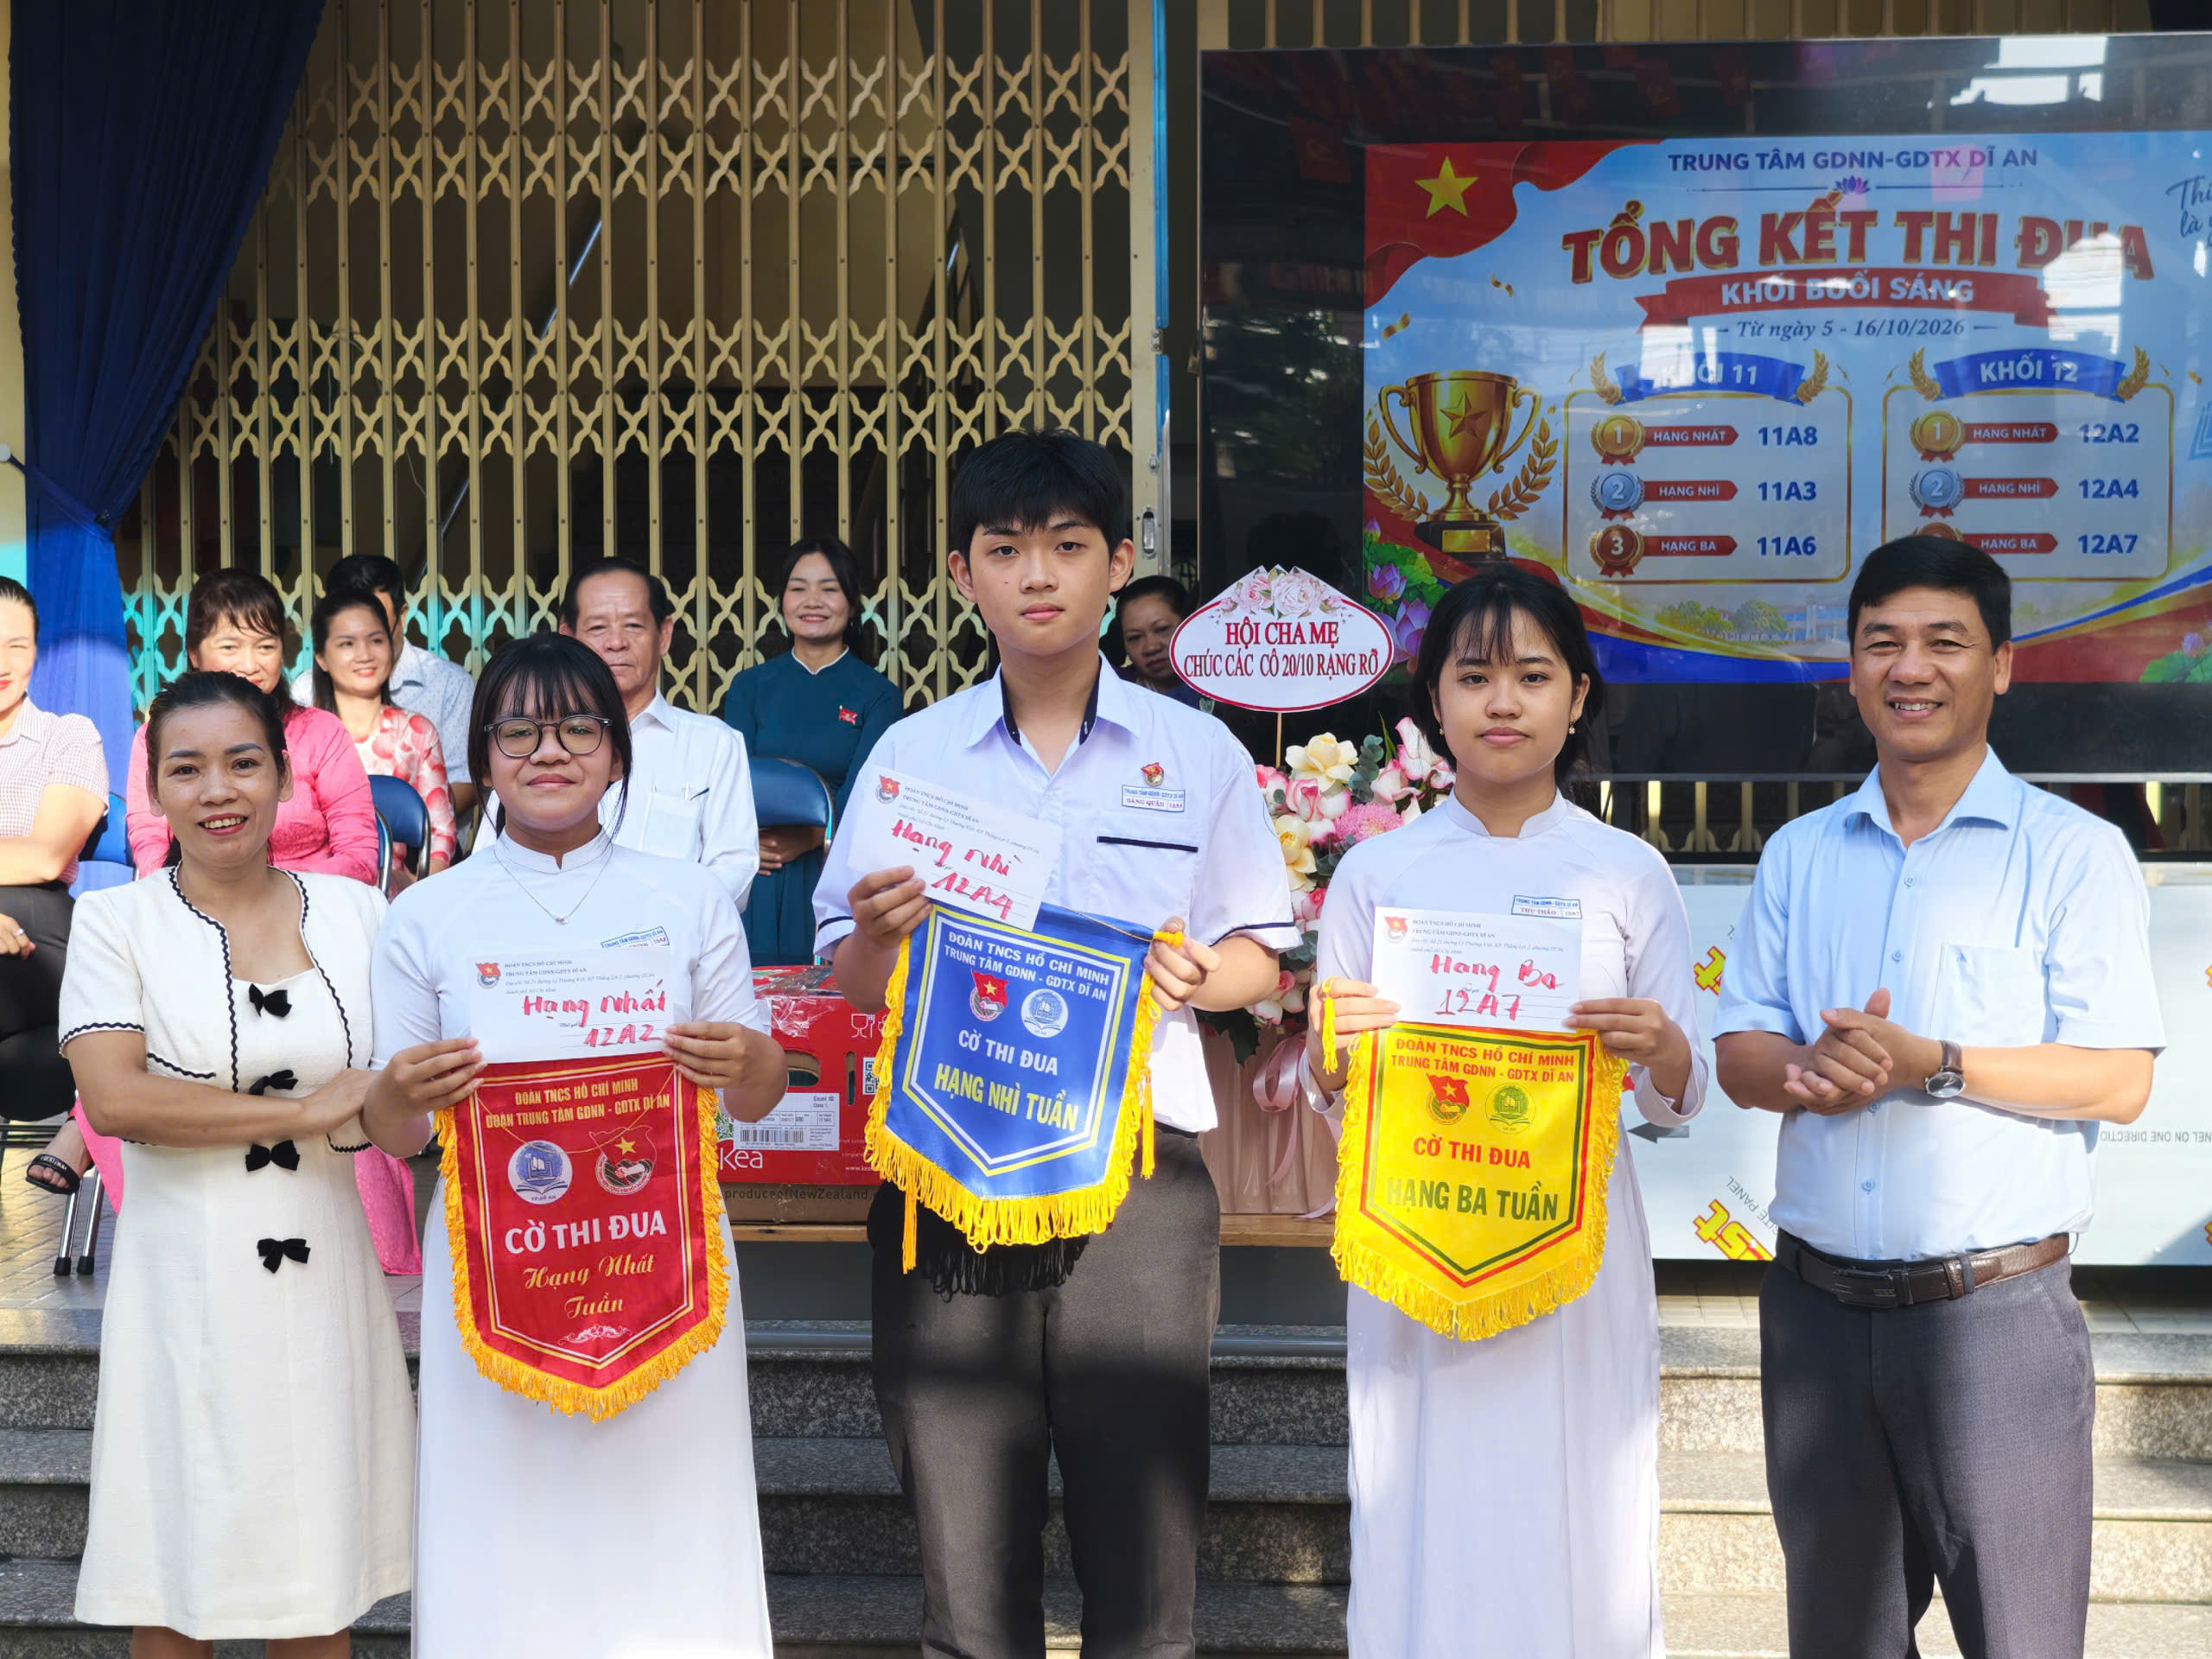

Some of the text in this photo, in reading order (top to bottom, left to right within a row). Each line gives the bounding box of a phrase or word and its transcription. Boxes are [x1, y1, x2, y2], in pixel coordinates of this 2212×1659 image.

[1668, 145, 2037, 172] TRUNG TÂM GDNN-GDTX DĨ AN
[1561, 200, 1740, 284] TỔNG
[1758, 190, 1878, 266] KẾT
[1893, 210, 1999, 267] THI
[1890, 272, 1974, 302] SÁNG
[1737, 317, 1965, 341] Từ ngày 5 16/10/2026
[1732, 364, 1758, 385] 11
[1979, 353, 2078, 384] KHỐI 12
[1613, 425, 1623, 445] 1
[1692, 428, 1726, 442] NHẤT
[1758, 426, 1818, 446] 11A8
[1931, 422, 1942, 441] 1
[2012, 423, 2046, 438] NHẤT
[2079, 423, 2139, 444] 12A2
[1611, 480, 1625, 500] 2
[1697, 484, 1720, 497] NHÌ
[1758, 480, 1817, 501] 11A3
[1930, 477, 1944, 498] 2
[2018, 480, 2040, 493] NHÌ
[2078, 478, 2139, 499] 12A4
[1611, 536, 1624, 556] 3
[1700, 541, 1717, 551] BA
[1756, 536, 1817, 556] 11A6
[2019, 538, 2037, 550] BA
[2077, 534, 2139, 554] 12A7
[1224, 615, 1339, 650] HỘI CHA MẸ
[1184, 647, 1379, 681] CHÚC CÁC CÔ 20/10 RẠNG RỠ
[890, 818, 954, 868] Hạng
[931, 871, 1014, 921] 12A4
[948, 931, 1110, 986] ĐOÀN TNCS HỒ CHÍ MINH
[944, 944, 976, 967] TRUNG
[978, 954, 1002, 974] TÂM
[1004, 963, 1037, 982] GDNN
[1045, 974, 1075, 993] GDTX
[1091, 987, 1107, 1002] AN
[1431, 953, 1565, 993] Hạng Ba
[523, 995, 590, 1028] Hạng
[1433, 988, 1526, 1021] 12A7
[583, 1023, 663, 1048] 12A2
[957, 1027, 1058, 1076] CỜ THI ĐUA
[1395, 1038, 1574, 1066] ĐOÀN TNCS HỒ CHÍ MINH
[1391, 1054, 1430, 1070] TRUNG
[1433, 1058, 1459, 1073] TÂM
[1463, 1063, 1497, 1077] GDNN
[1507, 1068, 1538, 1082] GDTX
[1557, 1071, 1574, 1083] AN
[515, 1077, 639, 1106] ĐOÀN TNCS HỒ CHÍ MINH
[933, 1063, 1080, 1133] HẠNG NHÌ TUẦN
[486, 1109, 515, 1128] ĐOÀN
[517, 1109, 550, 1127] TRUNG
[551, 1105, 574, 1123] TÂM
[576, 1104, 606, 1121] GDNN
[614, 1098, 640, 1116] GDTX
[656, 1094, 671, 1110] AN
[2151, 1130, 2171, 1142] ONE
[2174, 1130, 2190, 1142] ON
[720, 1147, 764, 1171] Kea
[1414, 1134, 1531, 1169] CỜ THI ĐUA
[1385, 1177, 1559, 1222] HẠNG BA TUẦN
[1726, 1175, 1759, 1212] PANEL
[505, 1210, 667, 1255] CỜ THI ĐUA
[522, 1250, 655, 1290] Hạng Nhất
[564, 1291, 624, 1320] Tuần
